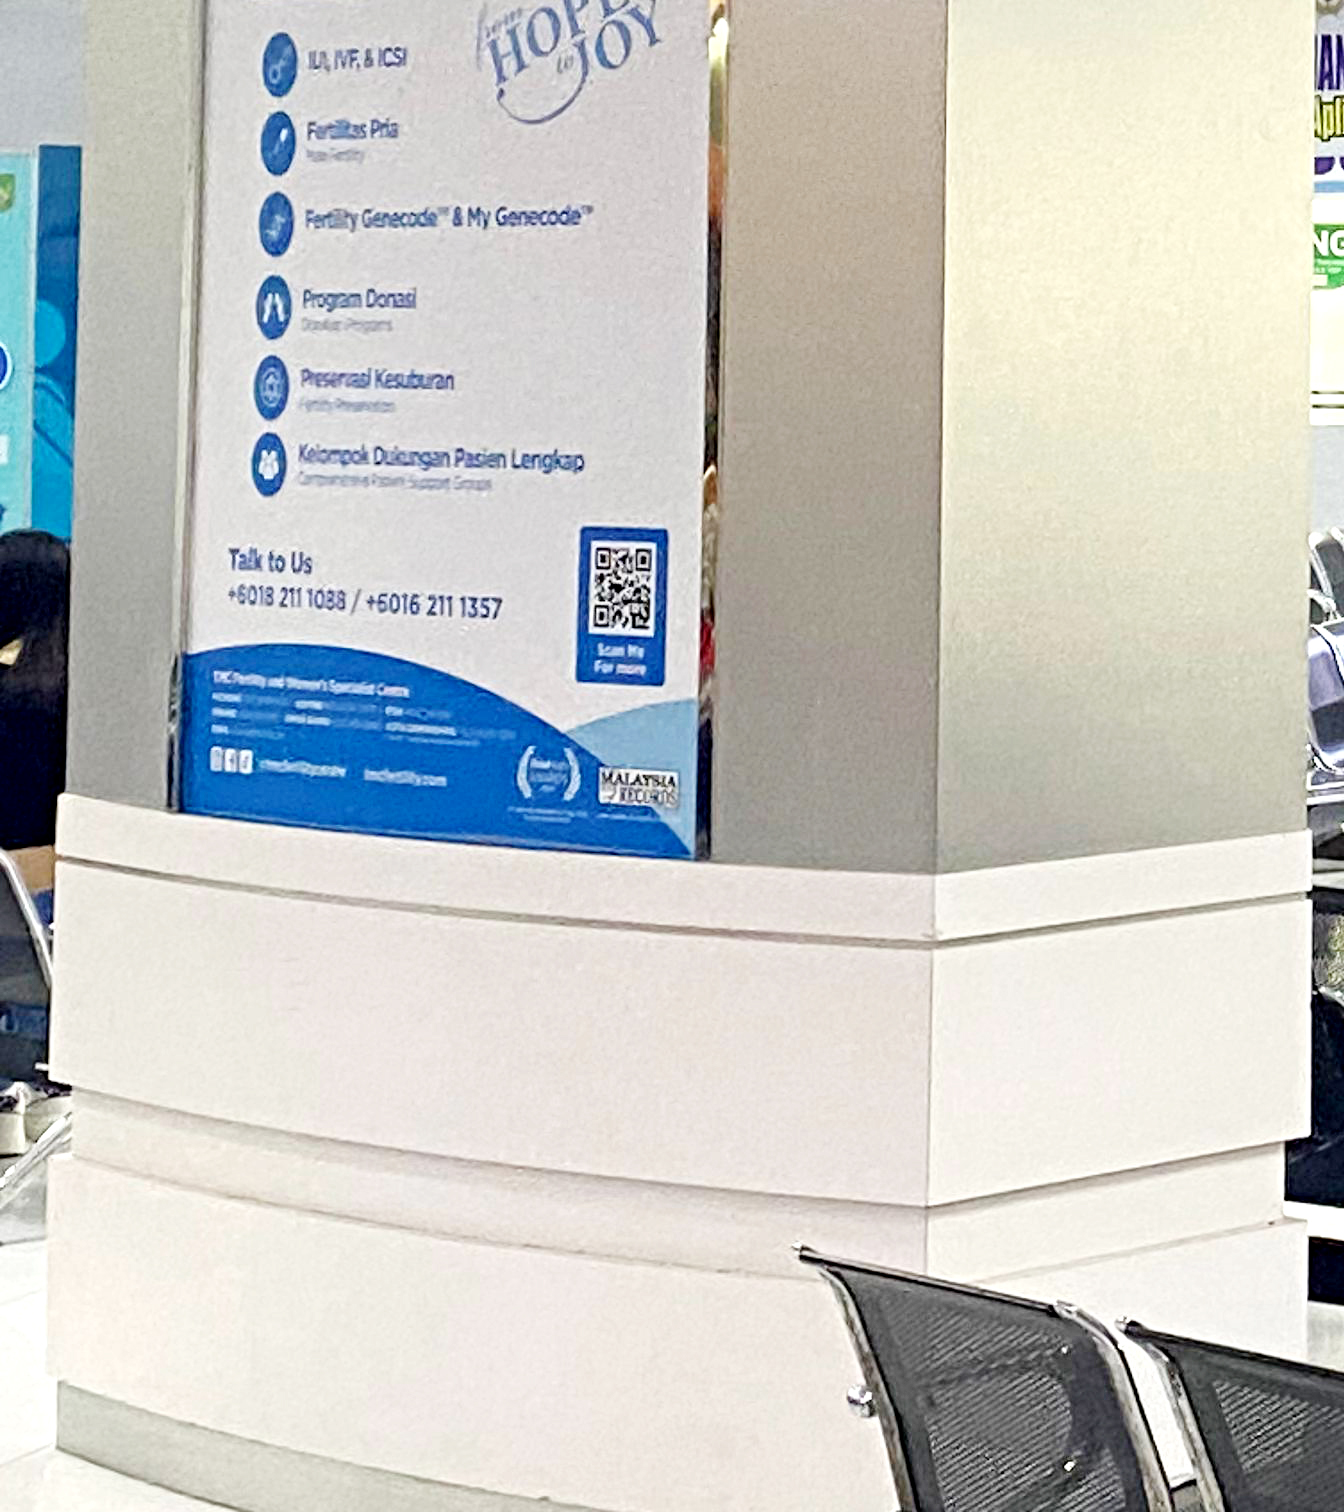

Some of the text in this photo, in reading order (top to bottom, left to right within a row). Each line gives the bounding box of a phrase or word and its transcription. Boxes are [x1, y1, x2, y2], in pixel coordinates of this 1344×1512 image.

[377, 47, 407, 68] ICSI
[370, 118, 399, 139] Pria
[452, 207, 463, 227] &
[467, 207, 490, 231] My
[302, 288, 417, 313] Program Donasi
[453, 447, 507, 470] Pasien
[511, 449, 585, 475] Lengkap
[229, 548, 313, 575] Talk to Us
[278, 587, 302, 609] 211
[350, 588, 362, 615] /
[366, 592, 420, 615] +6016
[426, 594, 454, 617] 211
[459, 595, 503, 619] 1357
